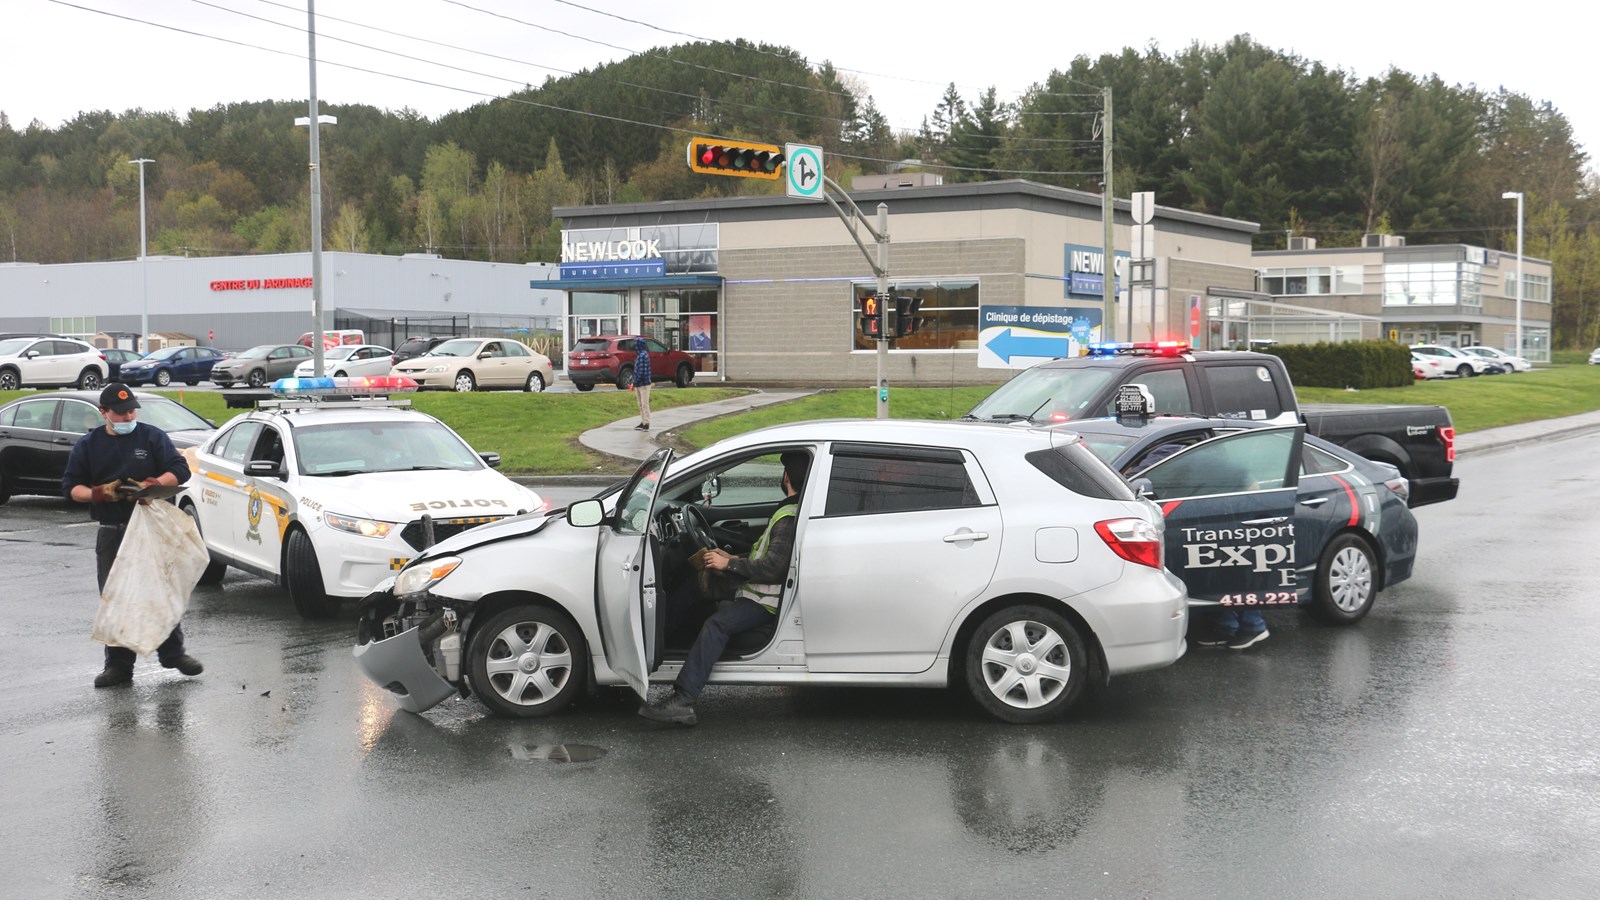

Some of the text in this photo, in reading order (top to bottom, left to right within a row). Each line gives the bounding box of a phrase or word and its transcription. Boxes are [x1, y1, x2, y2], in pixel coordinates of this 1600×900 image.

[562, 265, 661, 276] lunetterie
[210, 277, 313, 291] CENTRE DU JARDINAGE
[985, 312, 1074, 325] Clinique de dépistage
[299, 496, 322, 511] POLICE
[1181, 523, 1295, 542] Transport
[1220, 592, 1298, 606] 418.221
